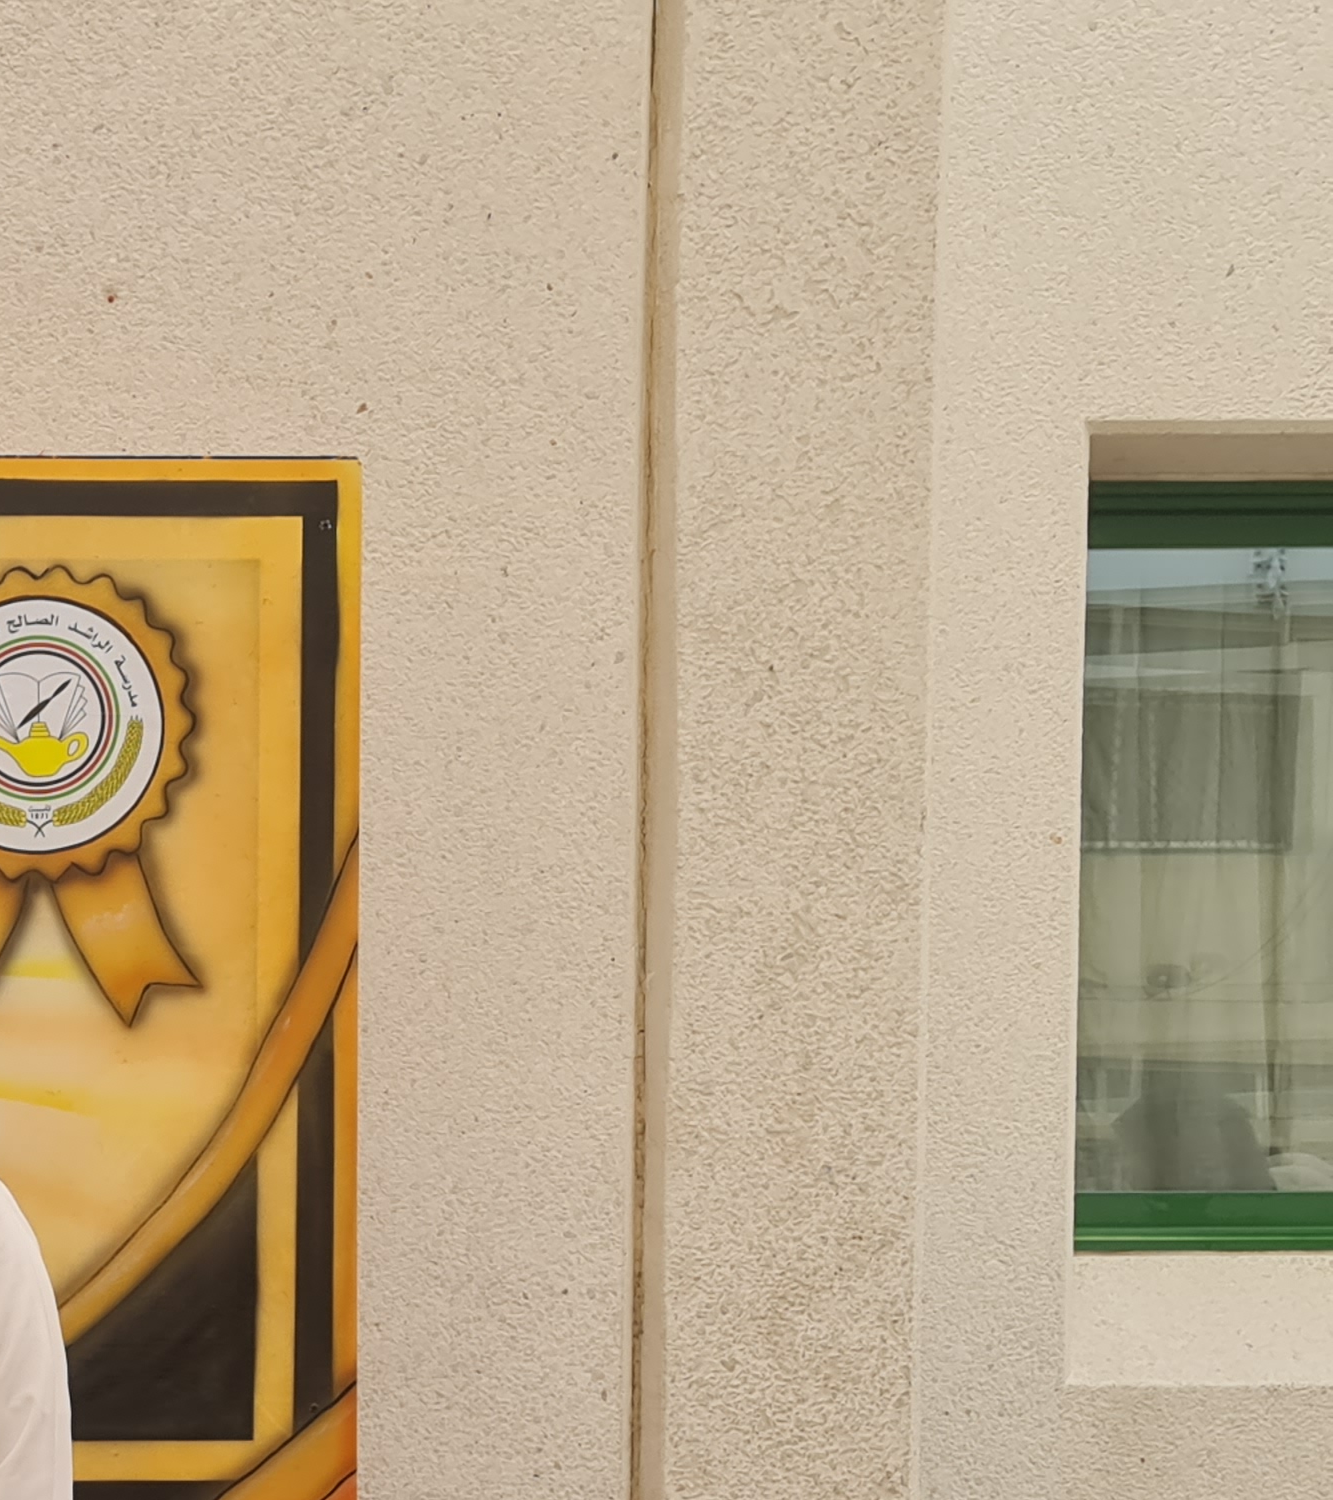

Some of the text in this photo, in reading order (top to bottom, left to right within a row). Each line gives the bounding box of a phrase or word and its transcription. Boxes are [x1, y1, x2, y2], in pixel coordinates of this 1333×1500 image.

[6, 614, 59, 634] الصالح
[67, 622, 113, 653] الراشد
[114, 654, 138, 707] مدرسة
